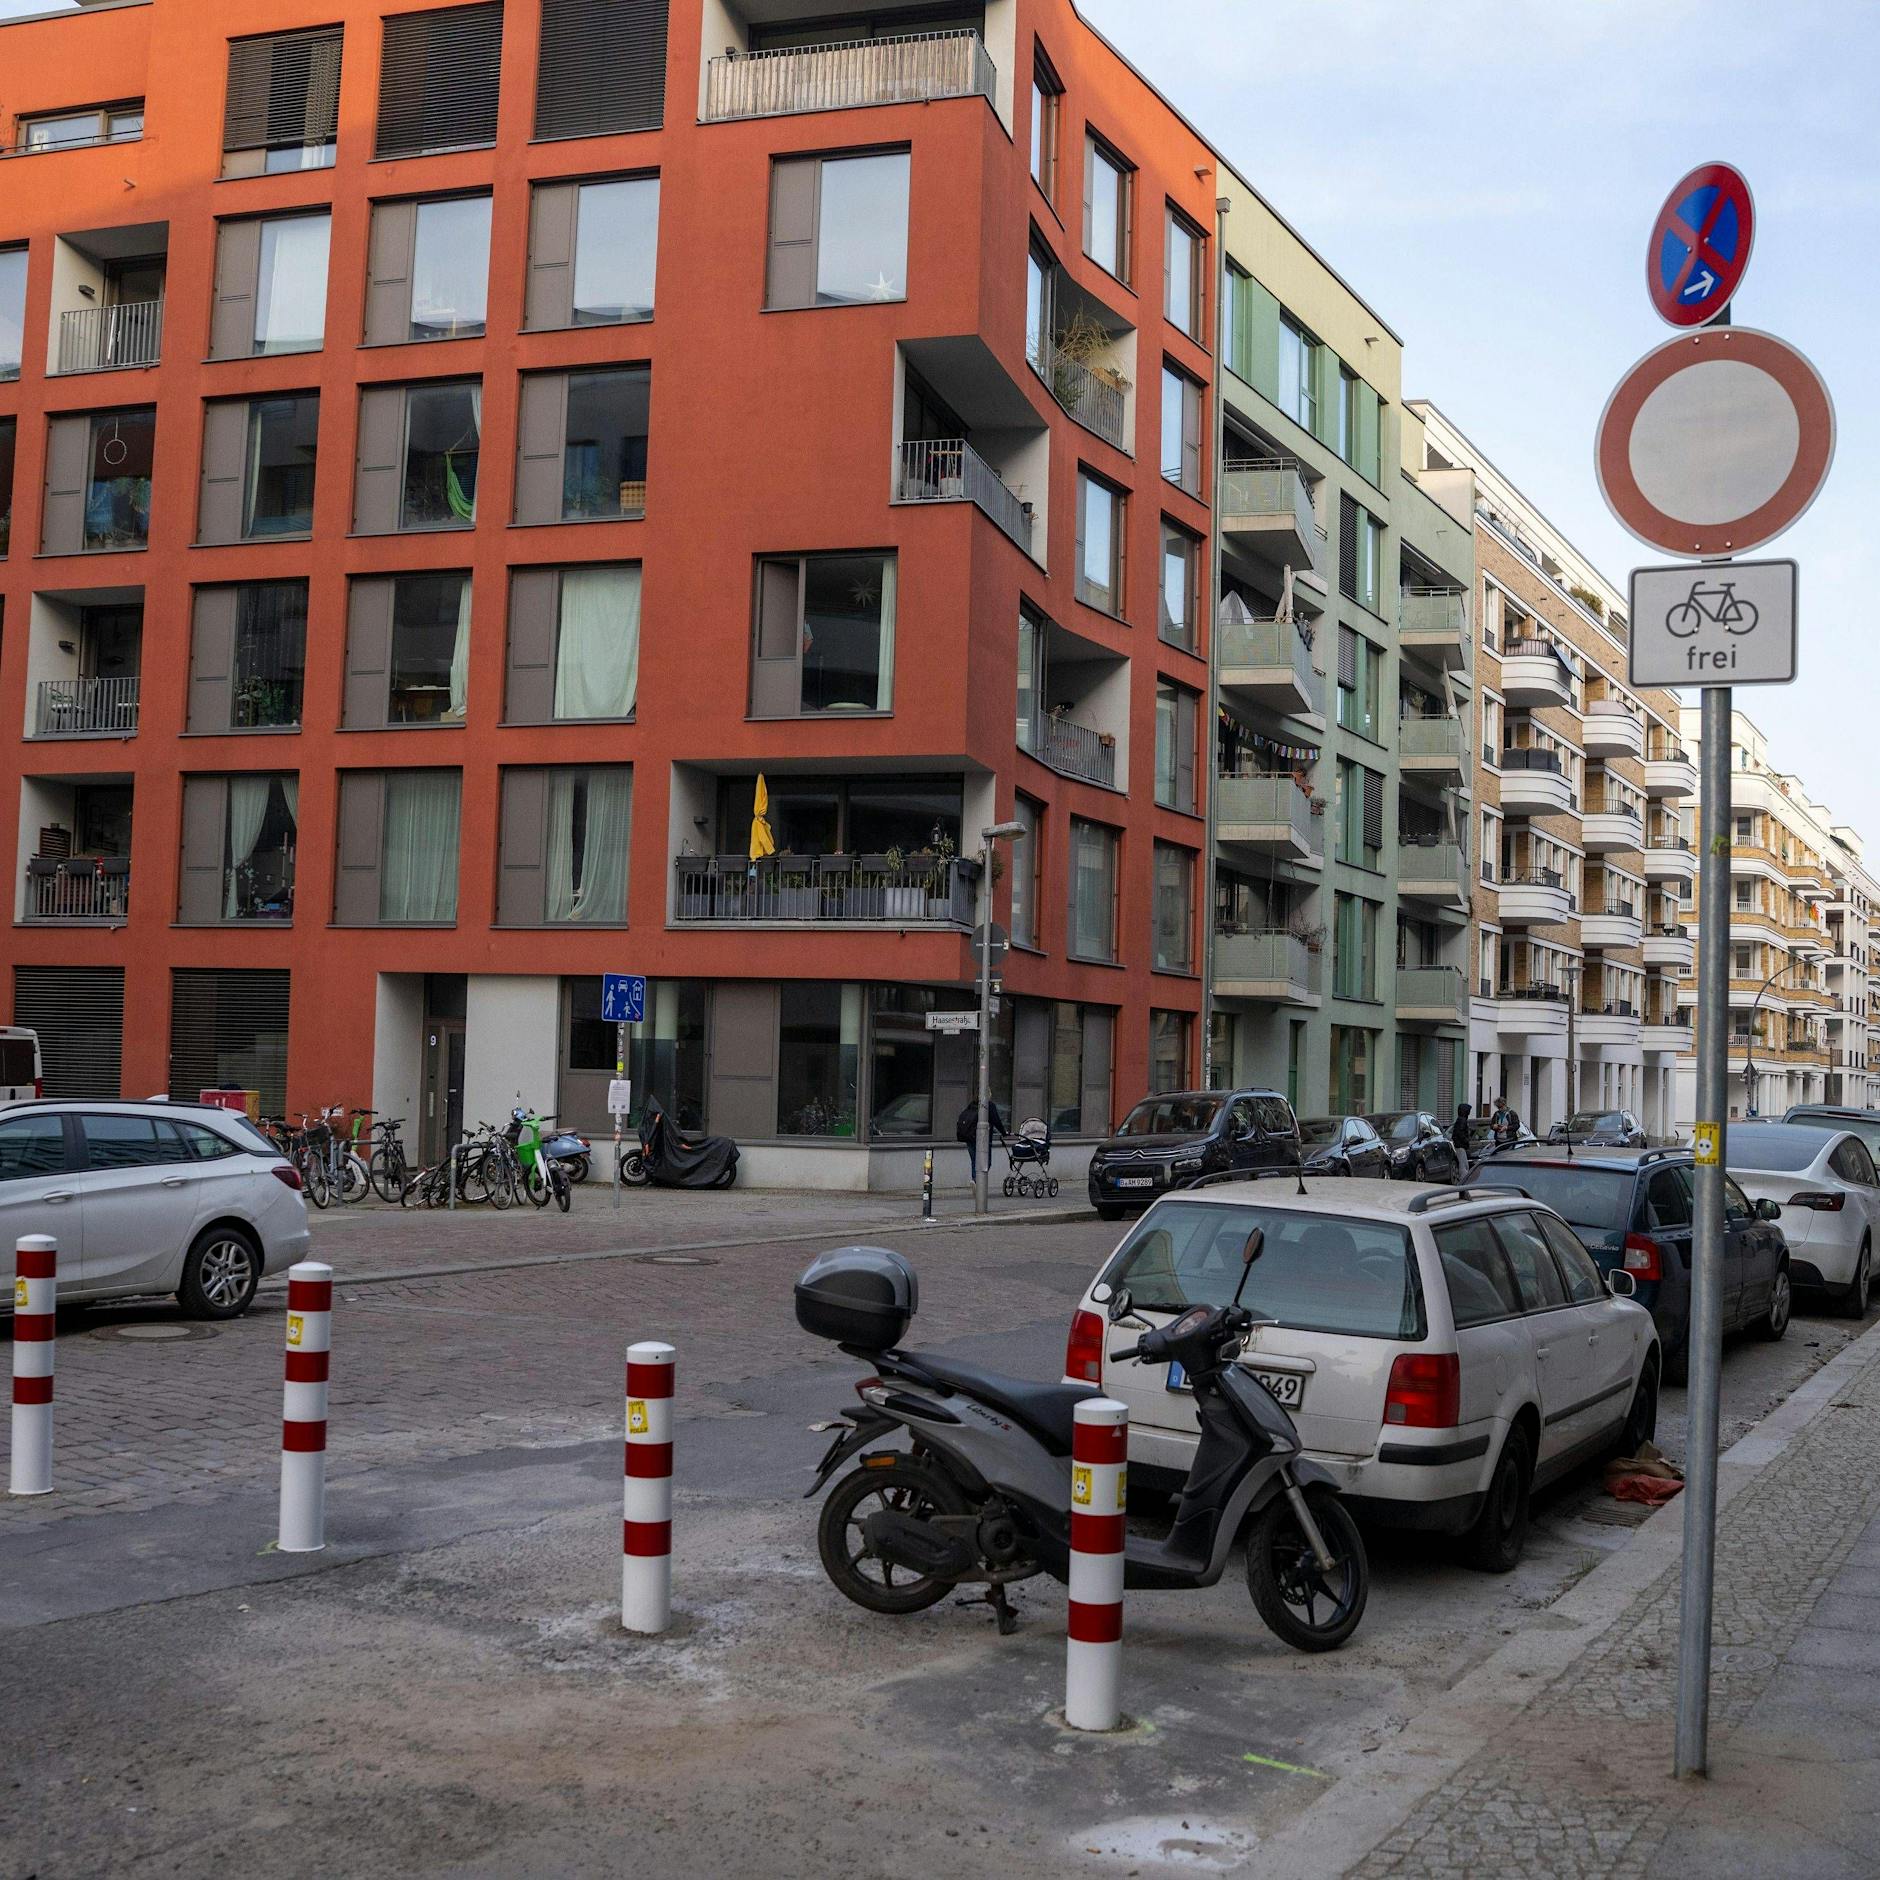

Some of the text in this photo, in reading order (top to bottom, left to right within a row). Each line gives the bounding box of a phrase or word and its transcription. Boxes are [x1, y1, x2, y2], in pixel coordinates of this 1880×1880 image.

[1687, 644, 1736, 669] frei
[430, 1035, 437, 1046] 9
[966, 1403, 1002, 1426] Liberty
